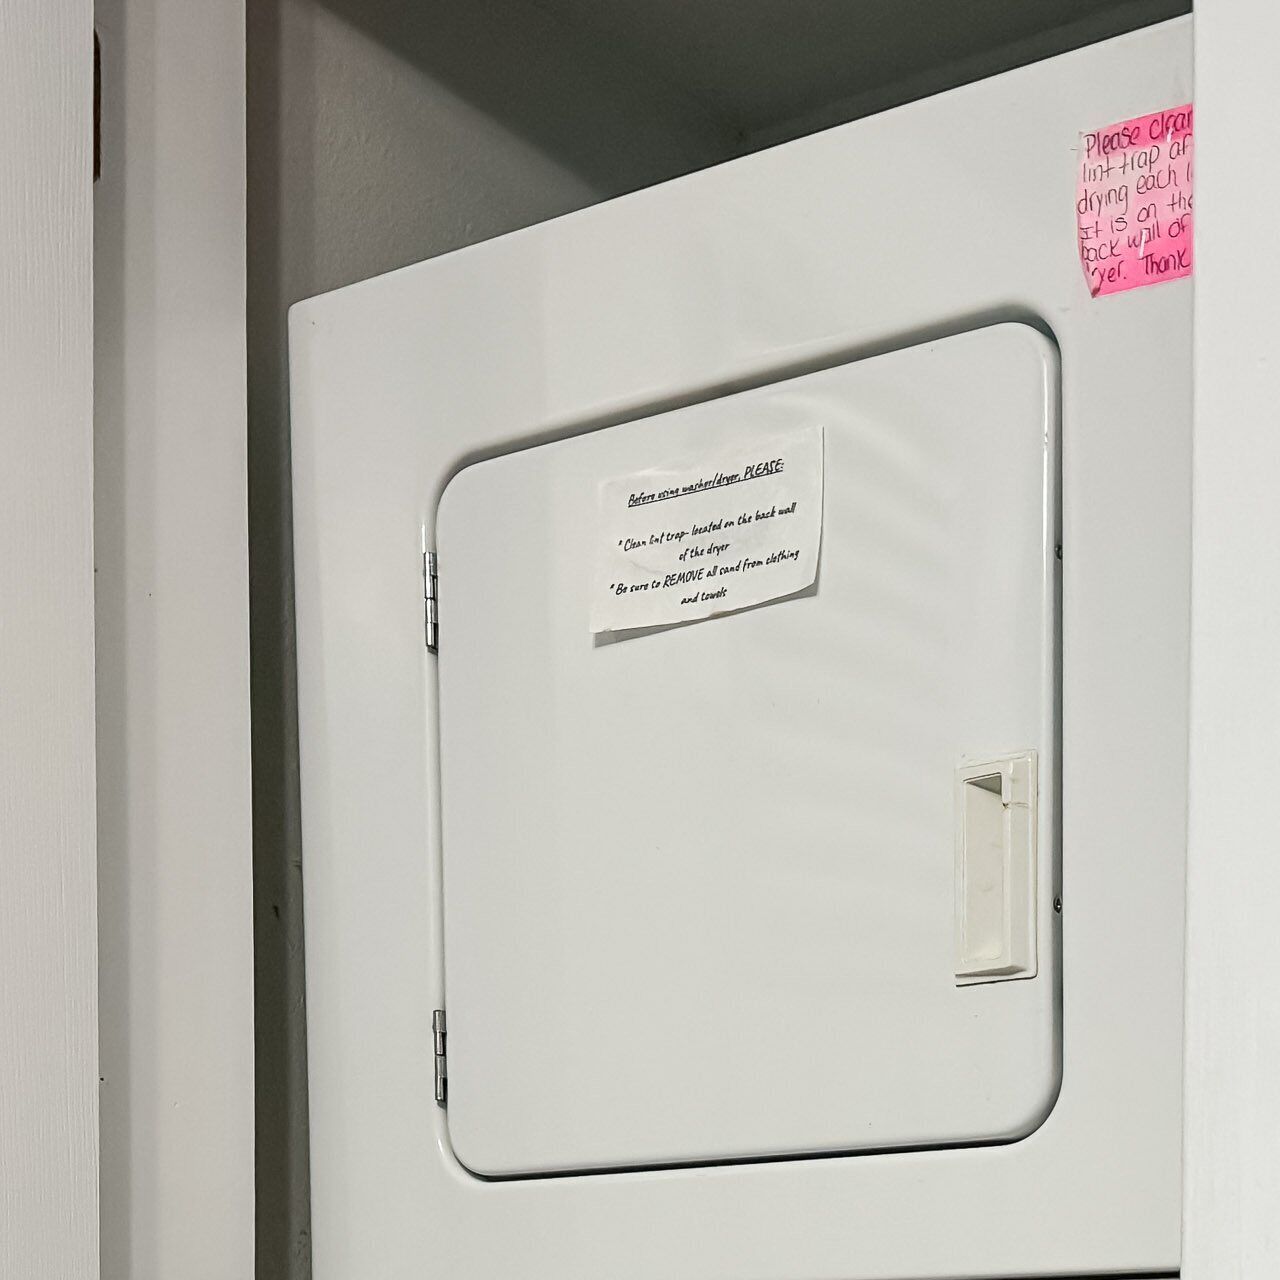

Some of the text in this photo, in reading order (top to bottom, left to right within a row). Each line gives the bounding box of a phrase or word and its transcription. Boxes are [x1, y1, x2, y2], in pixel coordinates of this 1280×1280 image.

[1083, 127, 1140, 158] Please
[1083, 156, 1115, 182] lint
[1119, 145, 1160, 175] trap
[1078, 185, 1128, 216] drying
[1137, 164, 1178, 194] each
[1080, 221, 1102, 240] It
[1111, 217, 1128, 234] is
[1137, 203, 1157, 222] on
[1081, 238, 1121, 262] back
[1168, 213, 1191, 238] of
[1139, 248, 1191, 275] Thank
[627, 492, 656, 506] Before
[657, 488, 680, 499] using
[743, 459, 785, 479] PLEASE:
[623, 538, 647, 551] Clean
[649, 532, 665, 544] lint
[691, 518, 723, 536] located
[724, 521, 735, 529] on
[737, 513, 752, 525] the
[755, 506, 776, 521] back
[778, 502, 797, 516] wall
[678, 543, 730, 562] of the dryer
[615, 550, 800, 595] Be sure to REMOVE all sand from clothing
[680, 587, 728, 605] and towels
